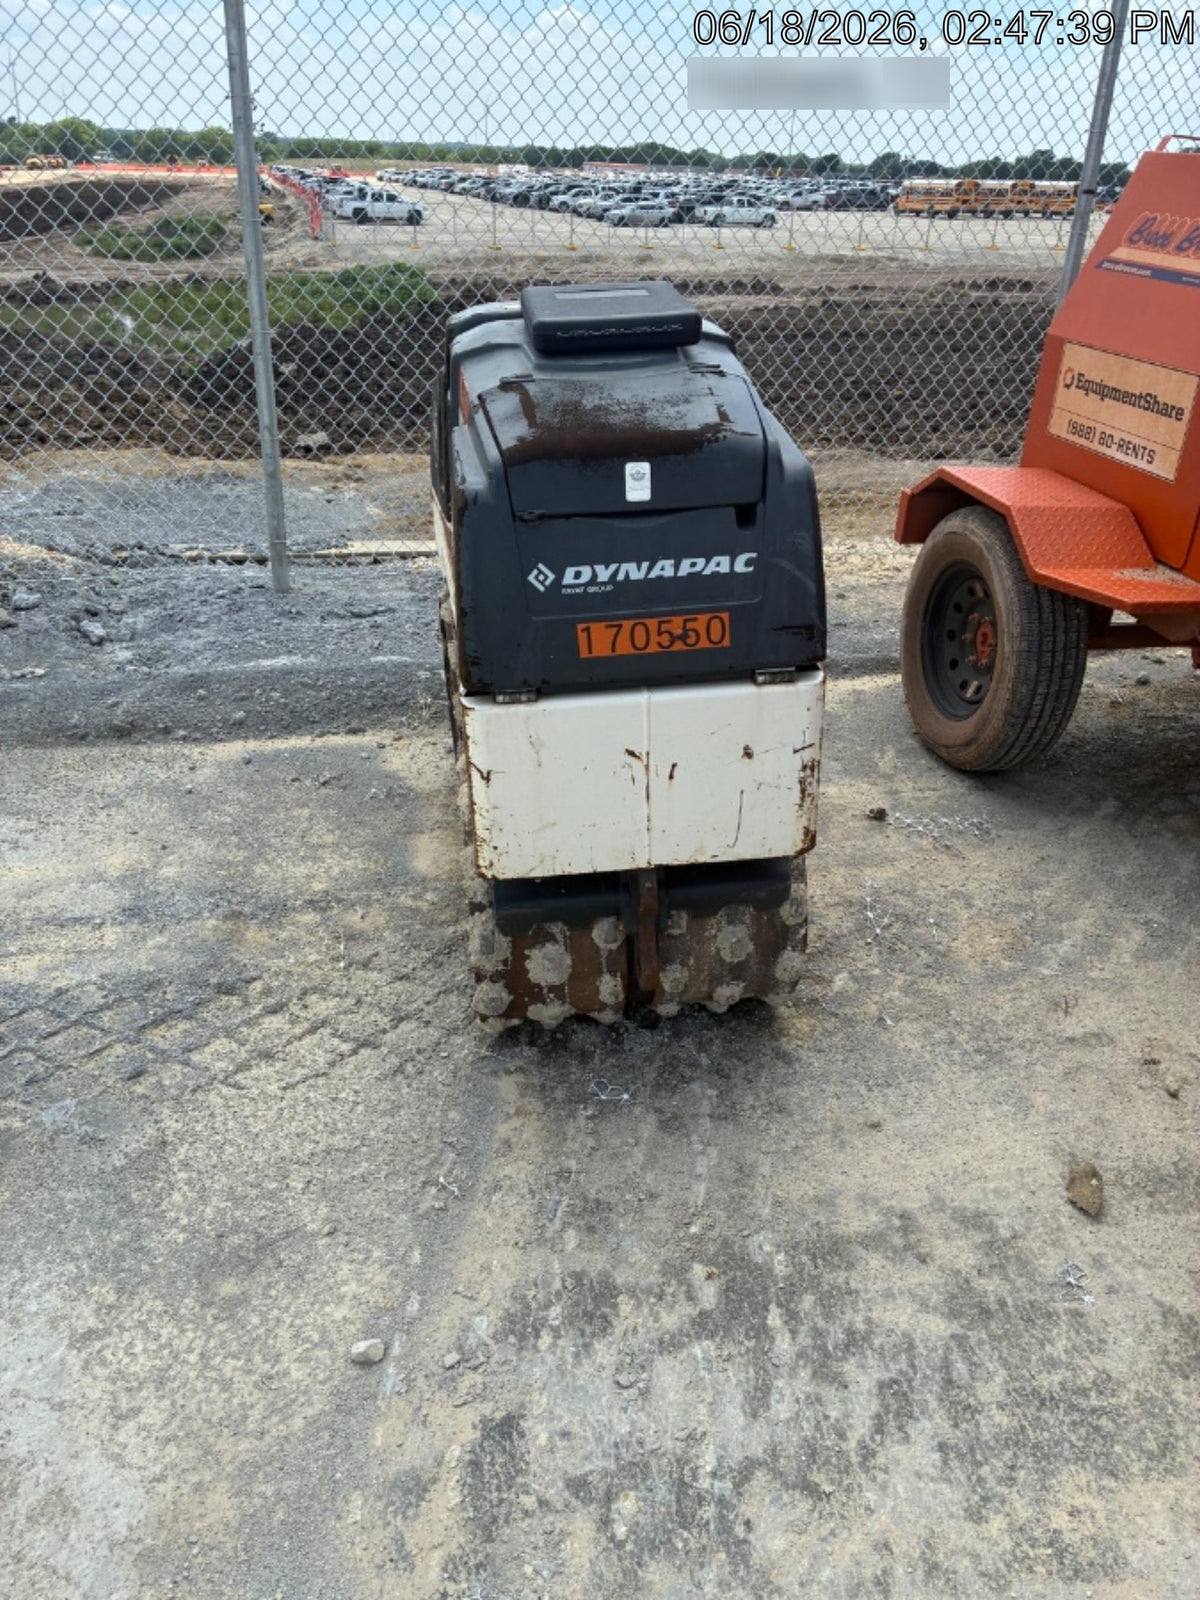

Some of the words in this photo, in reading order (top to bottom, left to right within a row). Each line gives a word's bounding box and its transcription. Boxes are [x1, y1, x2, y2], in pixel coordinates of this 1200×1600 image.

[1075, 372, 1185, 422] EquipmentShare
[1066, 418, 1097, 444] (888)
[1098, 430, 1157, 465] 80-RENTS
[561, 552, 758, 586] DYNAPAC
[580, 615, 727, 655] 170550
